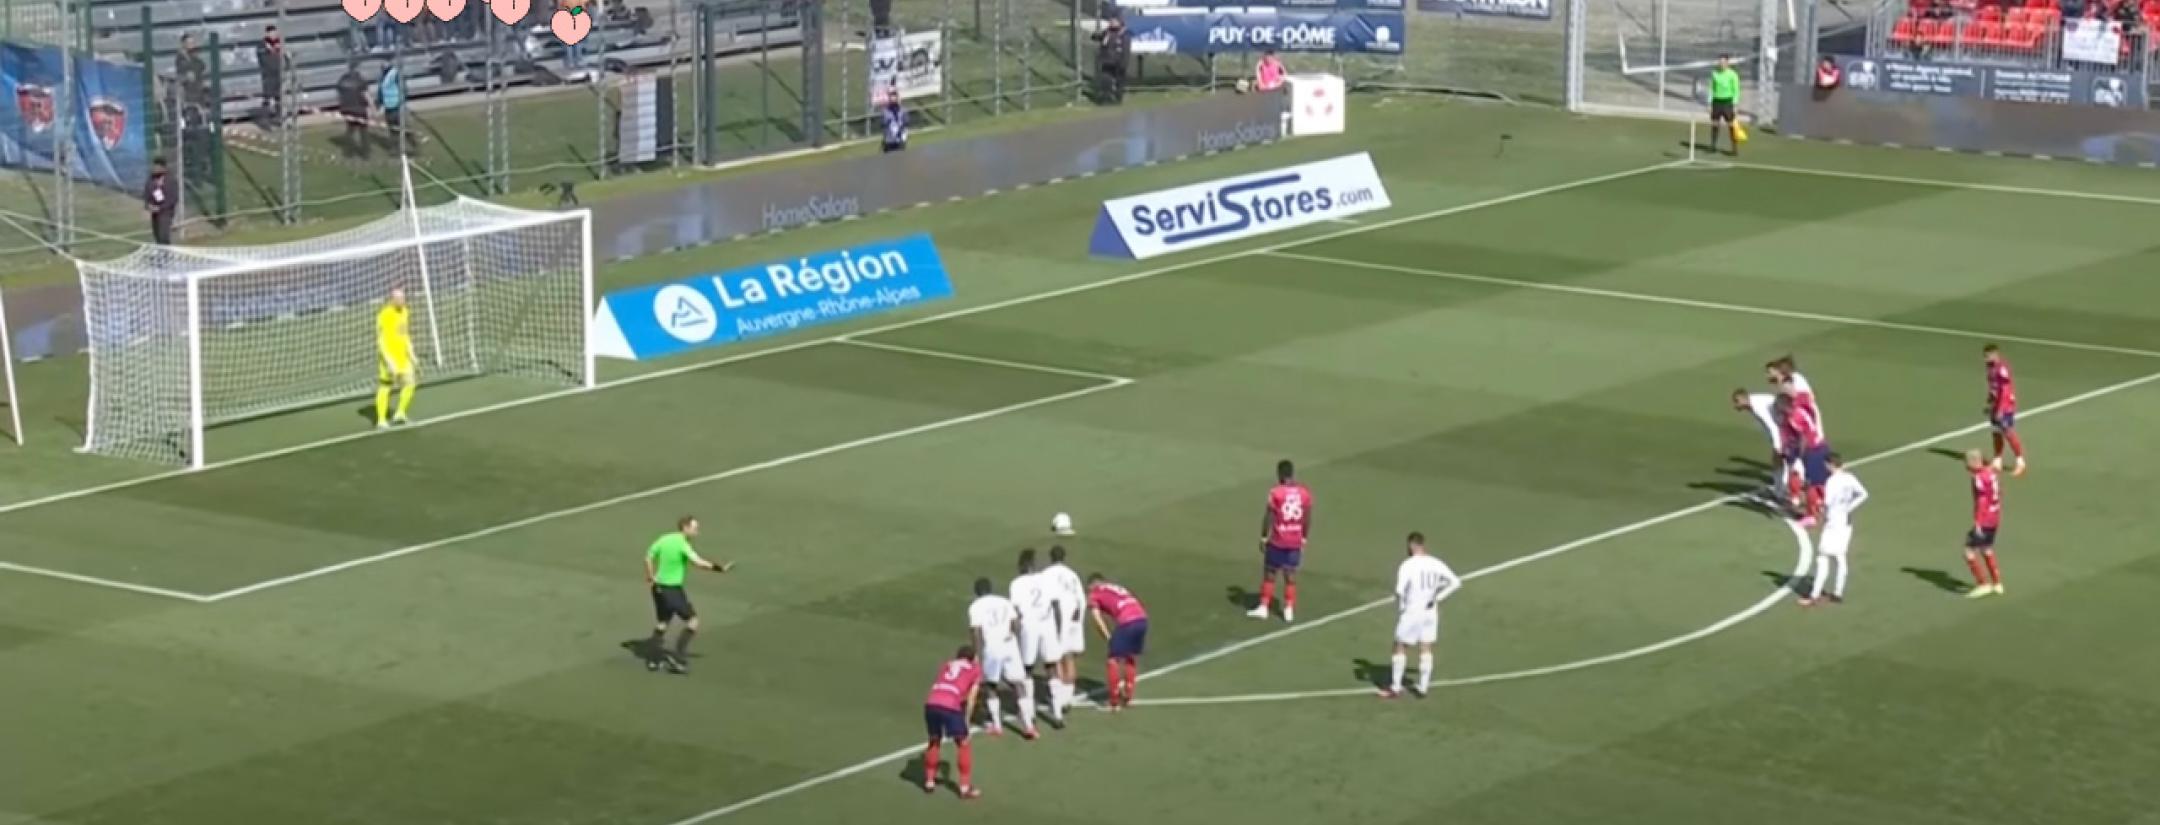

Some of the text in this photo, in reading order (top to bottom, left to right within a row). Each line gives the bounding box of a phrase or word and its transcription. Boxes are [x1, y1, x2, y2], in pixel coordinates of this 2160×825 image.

[1208, 23, 1337, 45] PUY-DE-DÔME
[762, 194, 859, 229] HomeSalons
[713, 249, 909, 309] La Région
[736, 284, 922, 336] Auvergne-Rhône-Alpes
[1030, 587, 1043, 608] 2
